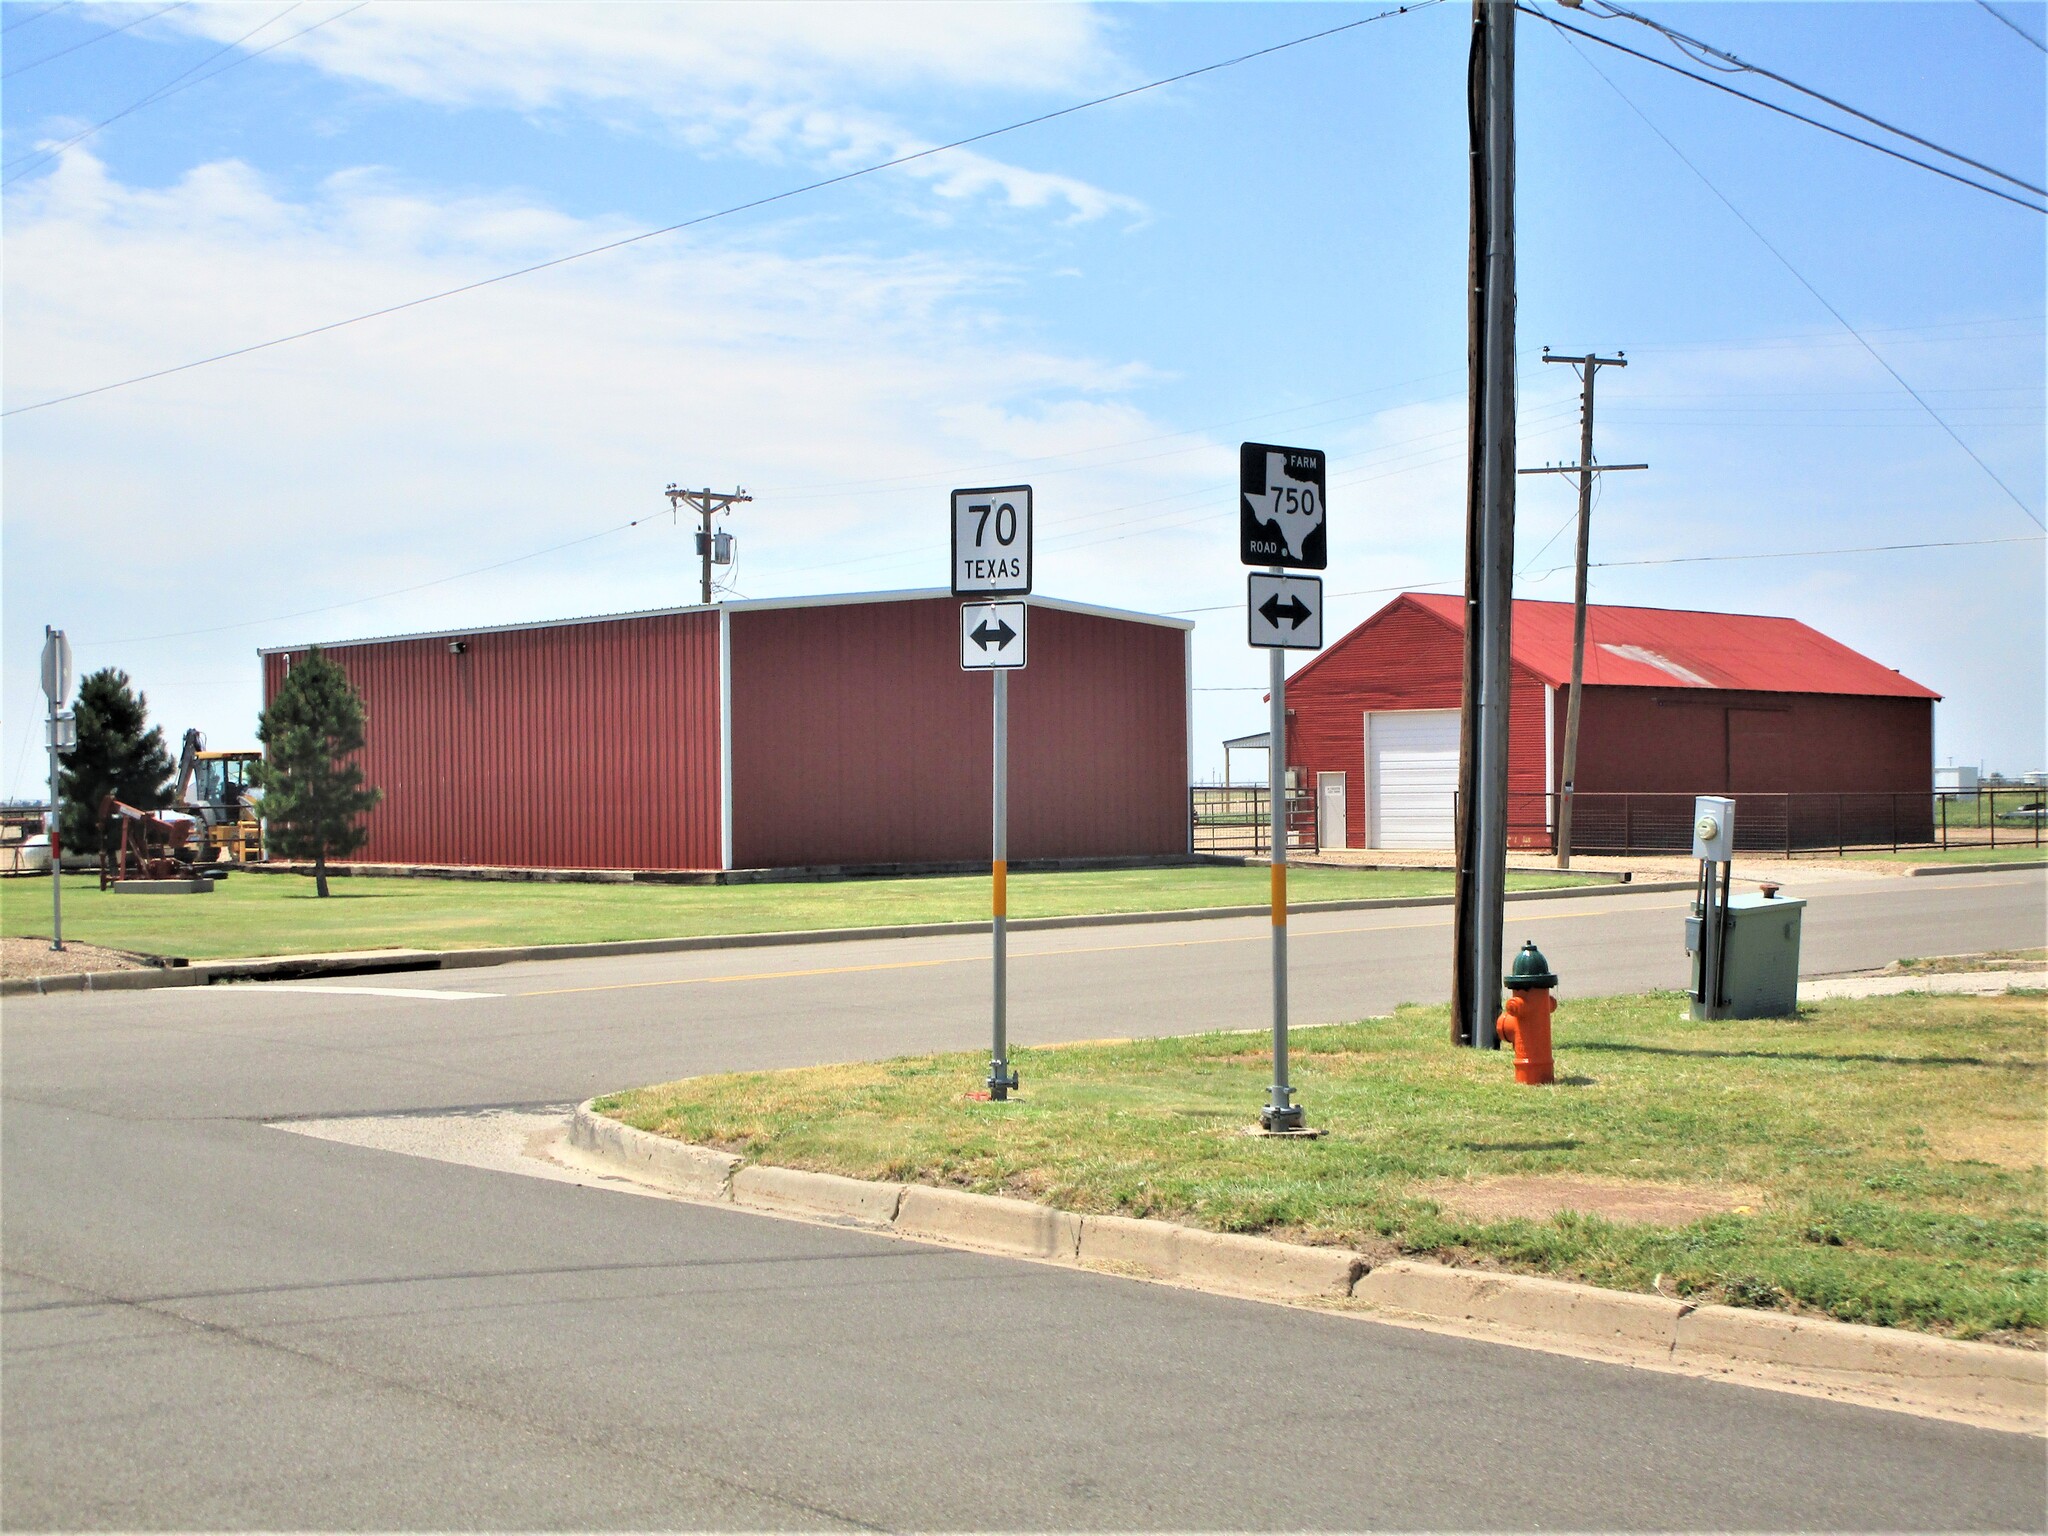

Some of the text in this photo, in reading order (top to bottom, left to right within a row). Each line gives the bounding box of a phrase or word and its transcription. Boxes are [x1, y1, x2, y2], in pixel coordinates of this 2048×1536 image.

[1291, 455, 1317, 469] FARM
[1271, 486, 1314, 516] 750
[969, 503, 1016, 547] 70
[1250, 540, 1277, 554] ROAD
[964, 558, 1020, 579] TEXAS
